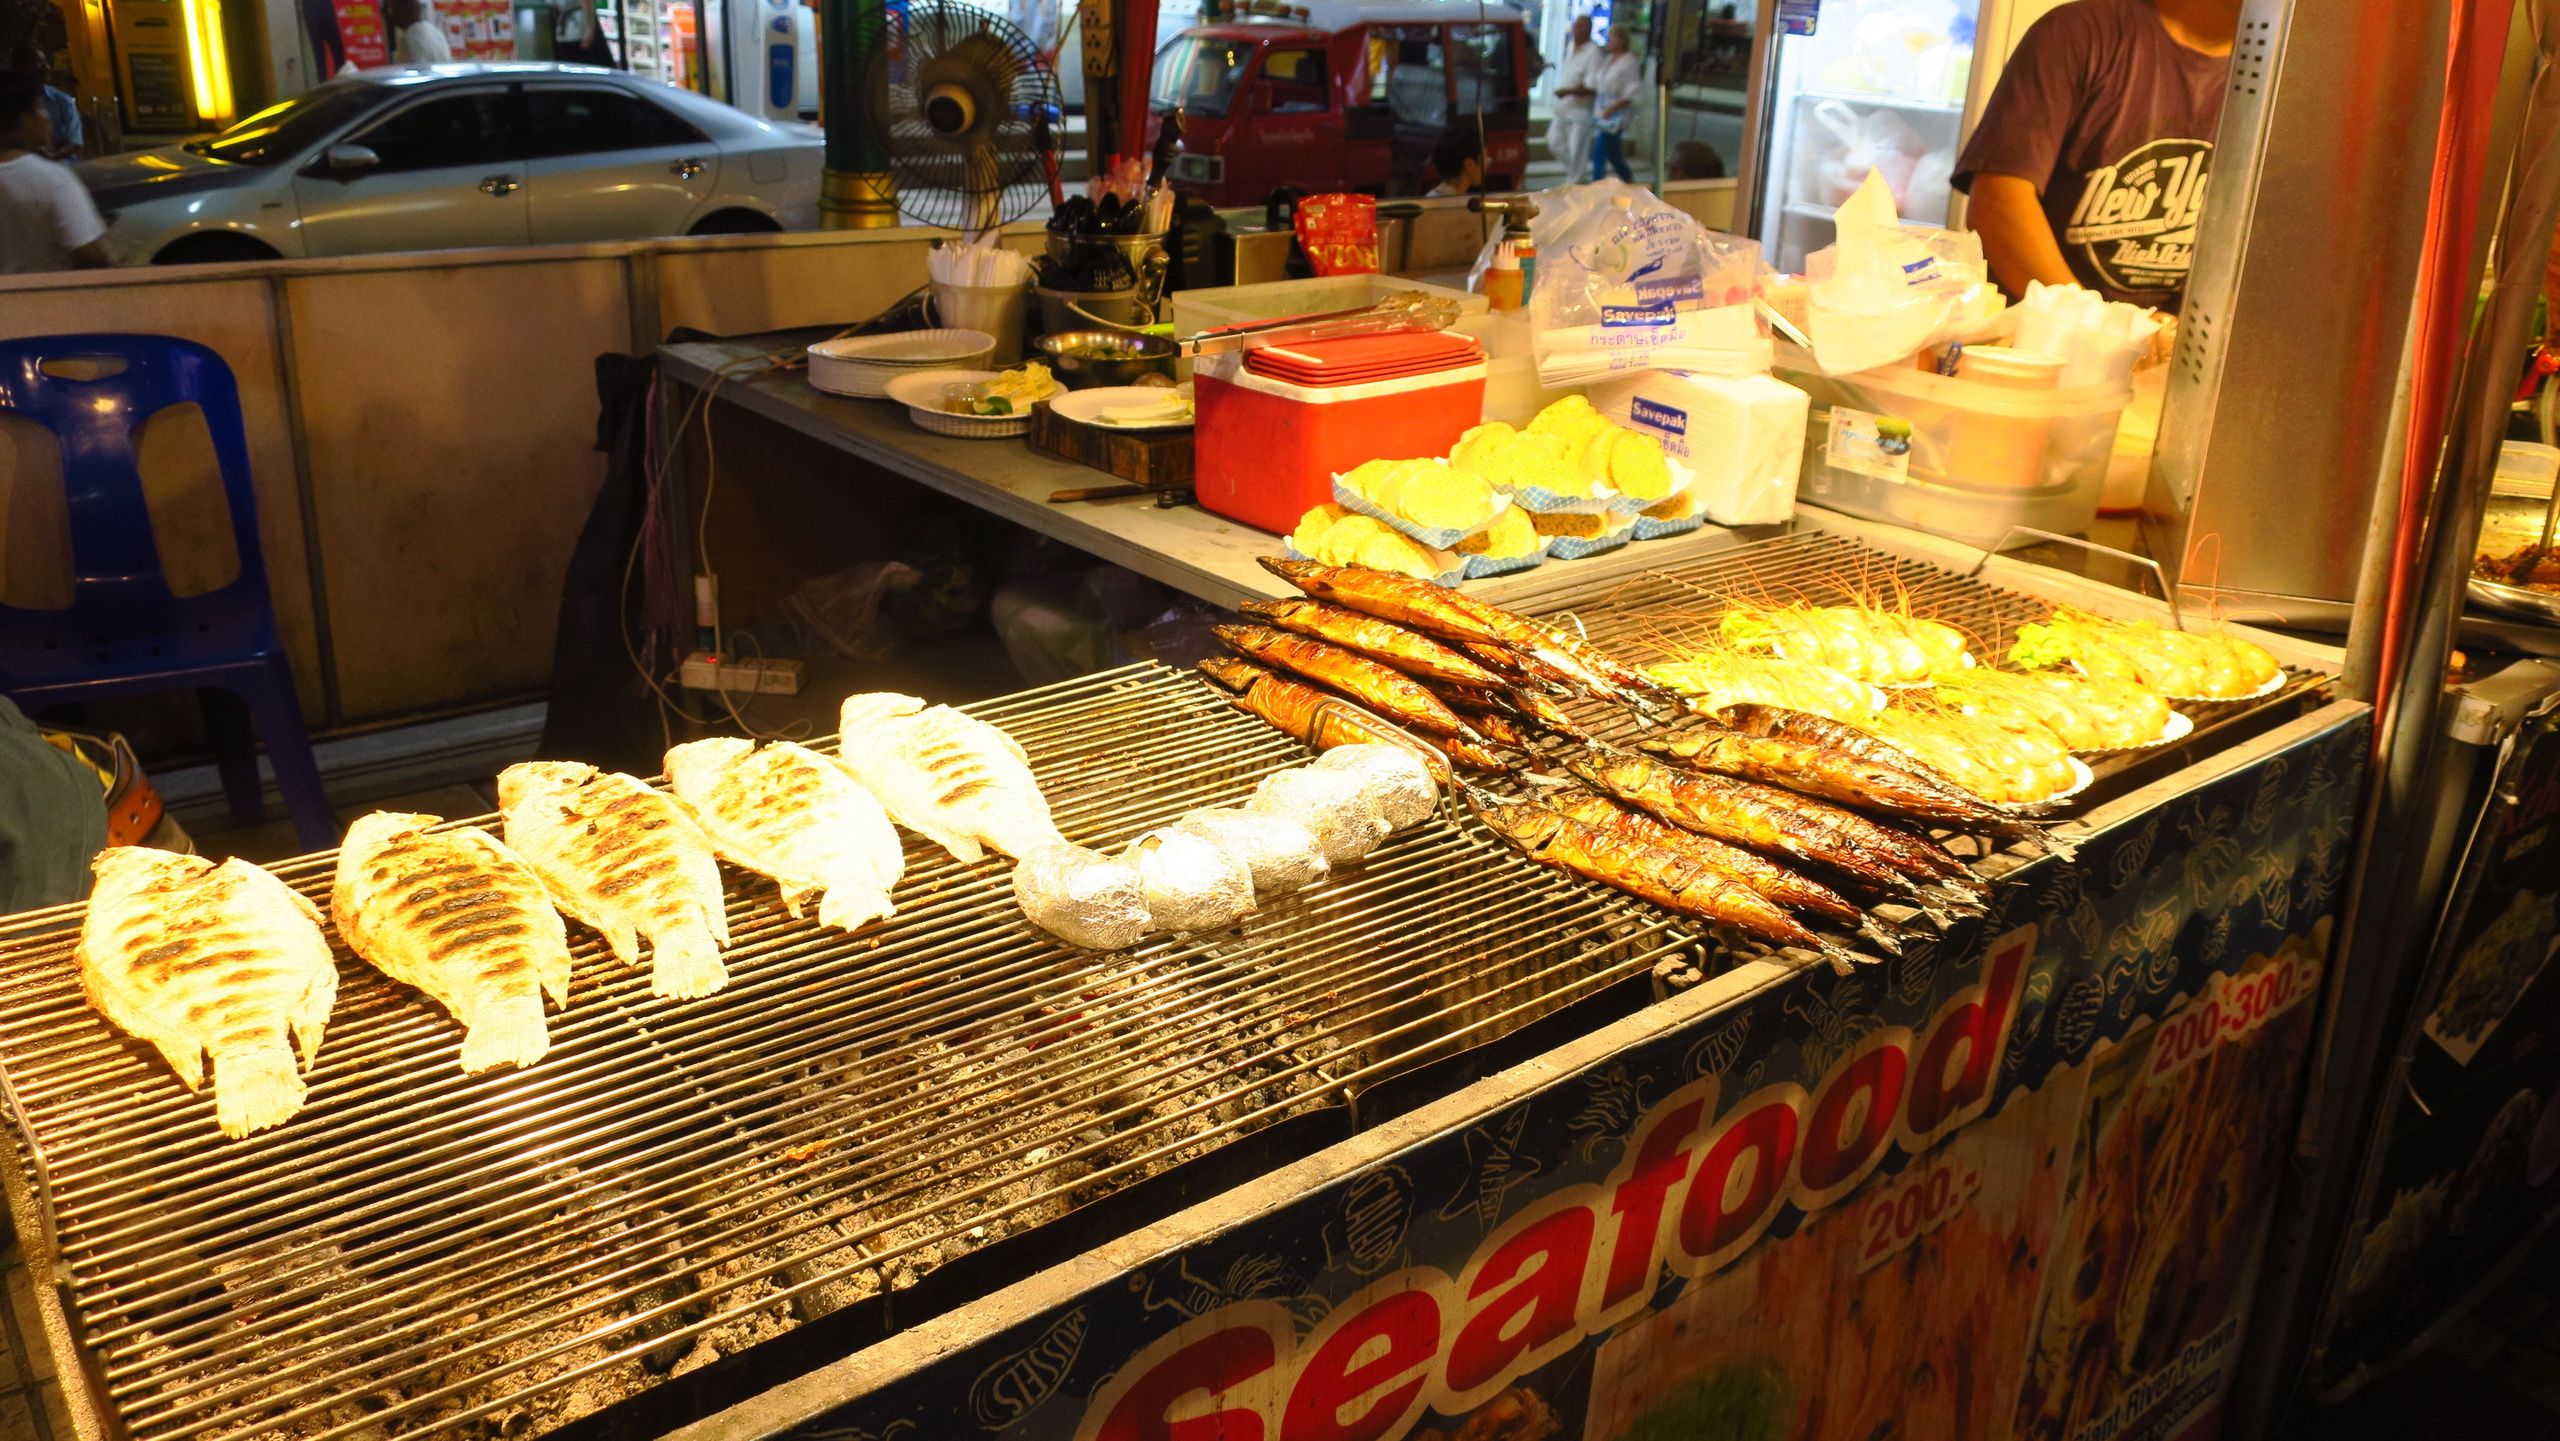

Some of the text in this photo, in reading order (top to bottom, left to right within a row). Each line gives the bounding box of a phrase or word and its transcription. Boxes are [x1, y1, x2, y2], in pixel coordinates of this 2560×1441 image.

[2070, 150, 2208, 230] New Yo
[1603, 303, 1675, 324] Savepak
[1632, 401, 1687, 429] Savepak
[1092, 935, 2036, 1441] Seafood
[1478, 1115, 1524, 1220] STARFISH
[1345, 1171, 1404, 1263] SCALLOP
[991, 1309, 1089, 1417] MUSSELS
[2125, 1364, 2177, 1423] River
[2180, 1320, 2238, 1380] Prawn
